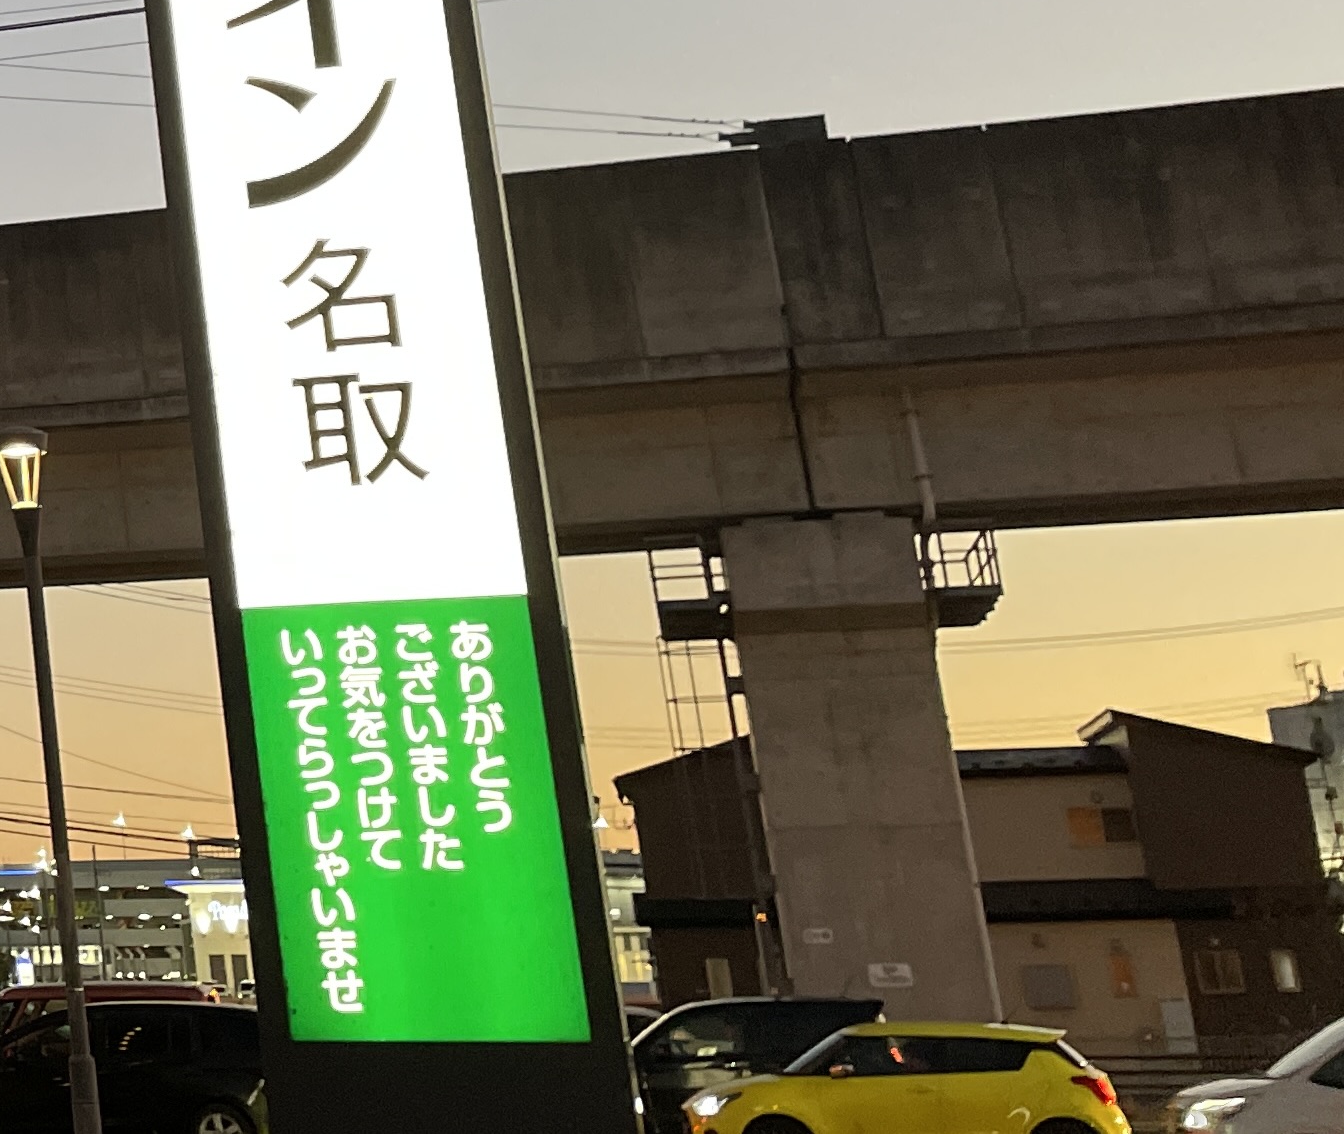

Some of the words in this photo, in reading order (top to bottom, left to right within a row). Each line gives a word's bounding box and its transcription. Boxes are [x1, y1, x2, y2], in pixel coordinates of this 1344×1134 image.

[280, 238, 429, 487] 名取
[279, 628, 365, 1015] いってらっしゃいませ
[335, 624, 403, 871] お気をつけて
[394, 622, 465, 871] ございました
[449, 620, 513, 833] ありがとう
